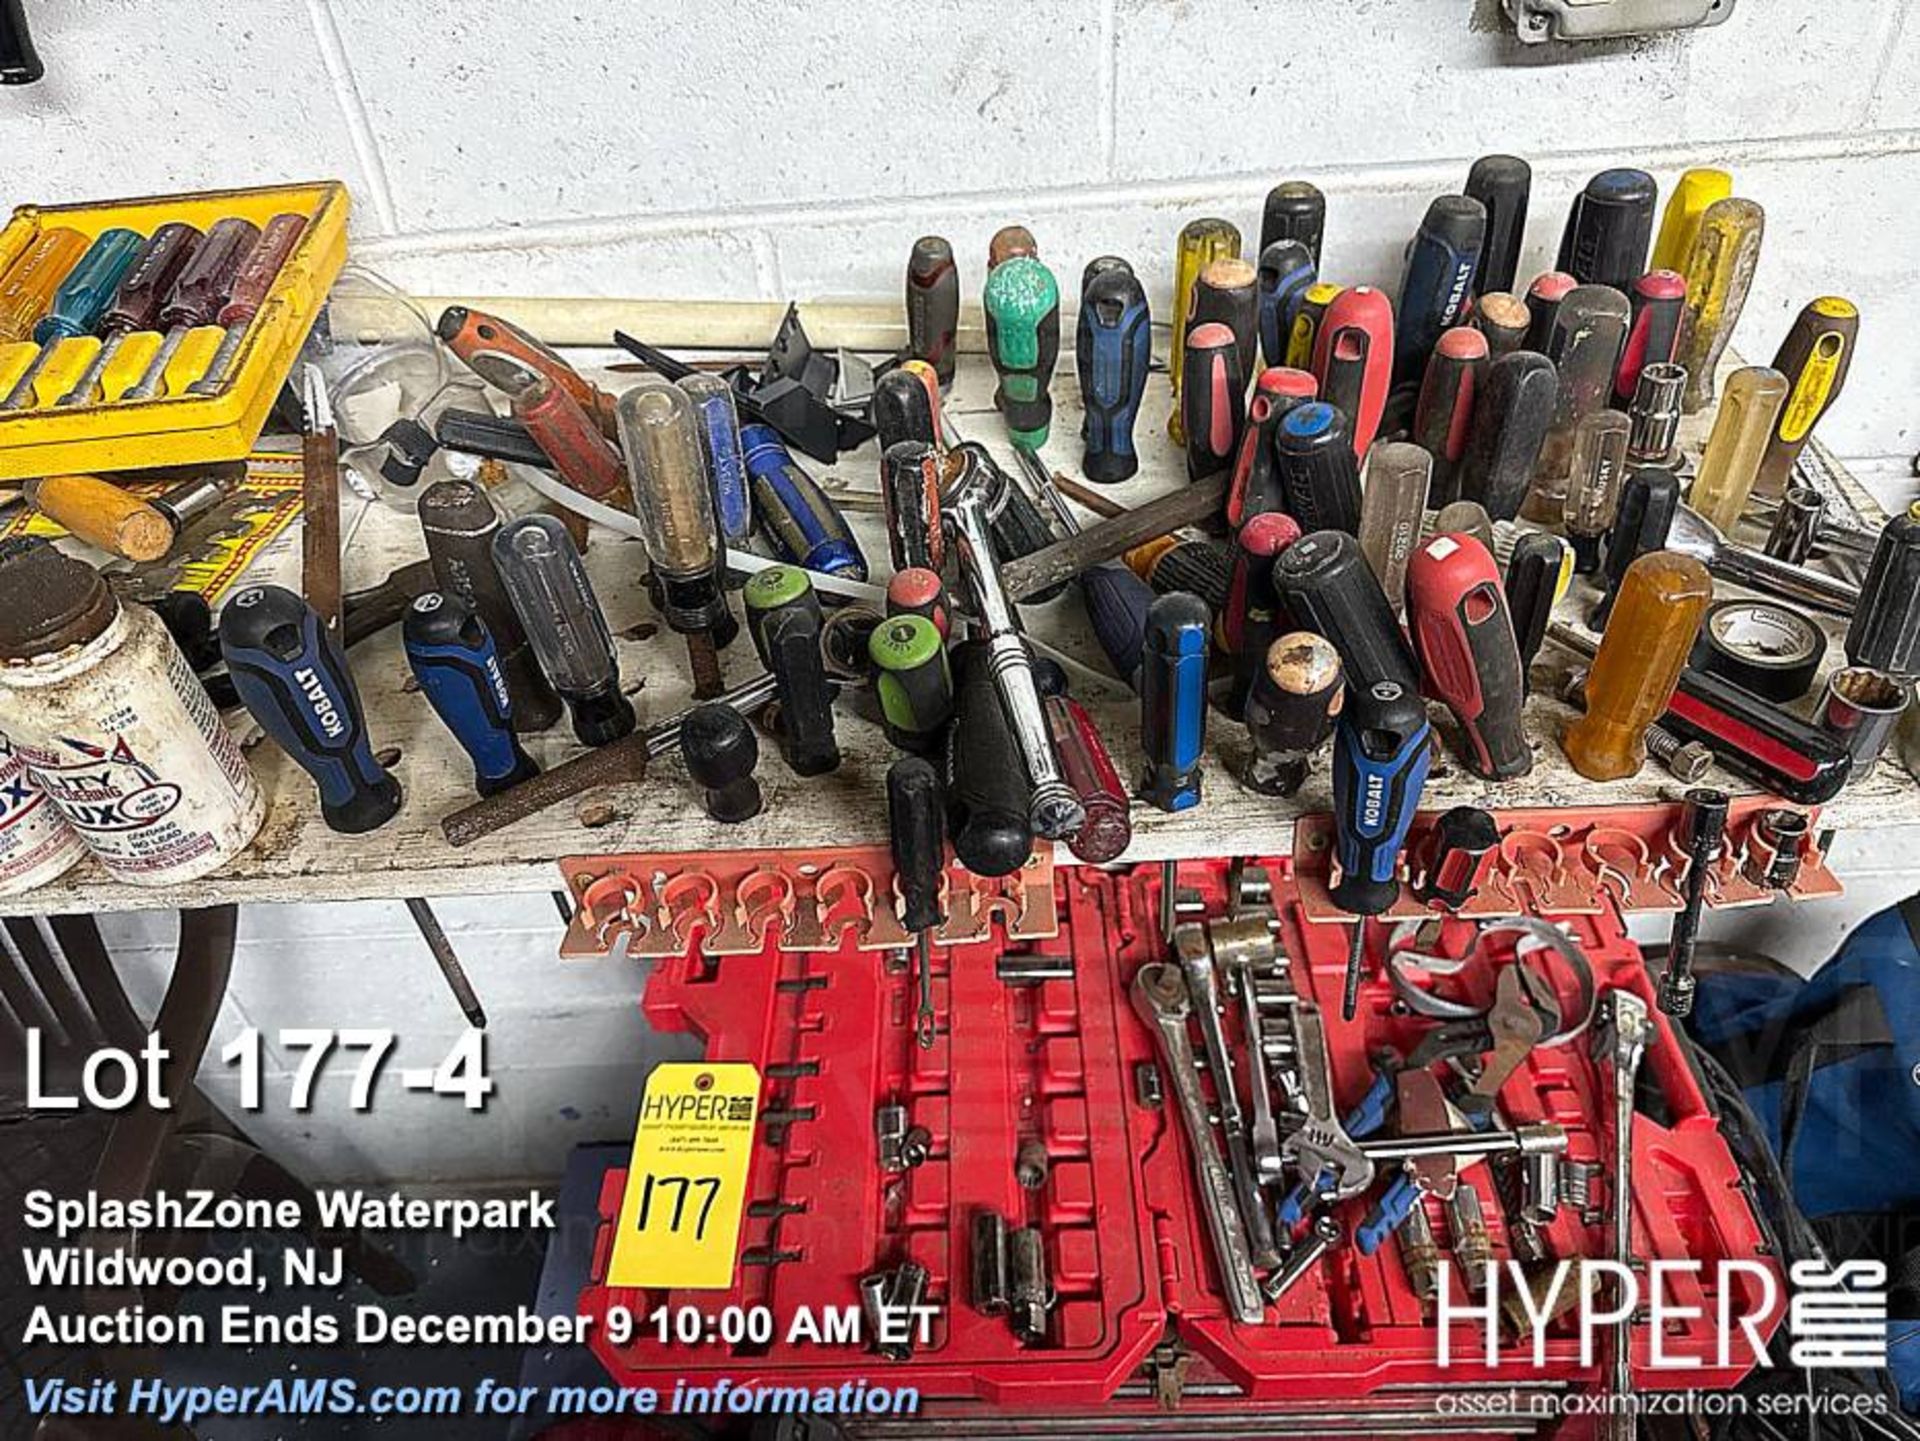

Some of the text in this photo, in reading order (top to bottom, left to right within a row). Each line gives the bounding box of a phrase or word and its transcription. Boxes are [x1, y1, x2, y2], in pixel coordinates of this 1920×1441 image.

[1440, 262, 1472, 327] KOBALT
[293, 666, 345, 738] KOBALT
[1363, 773, 1384, 827] KOBALT
[151, 828, 183, 847] LEAD
[643, 1094, 728, 1121] HYPER
[637, 1173, 721, 1241] 177
